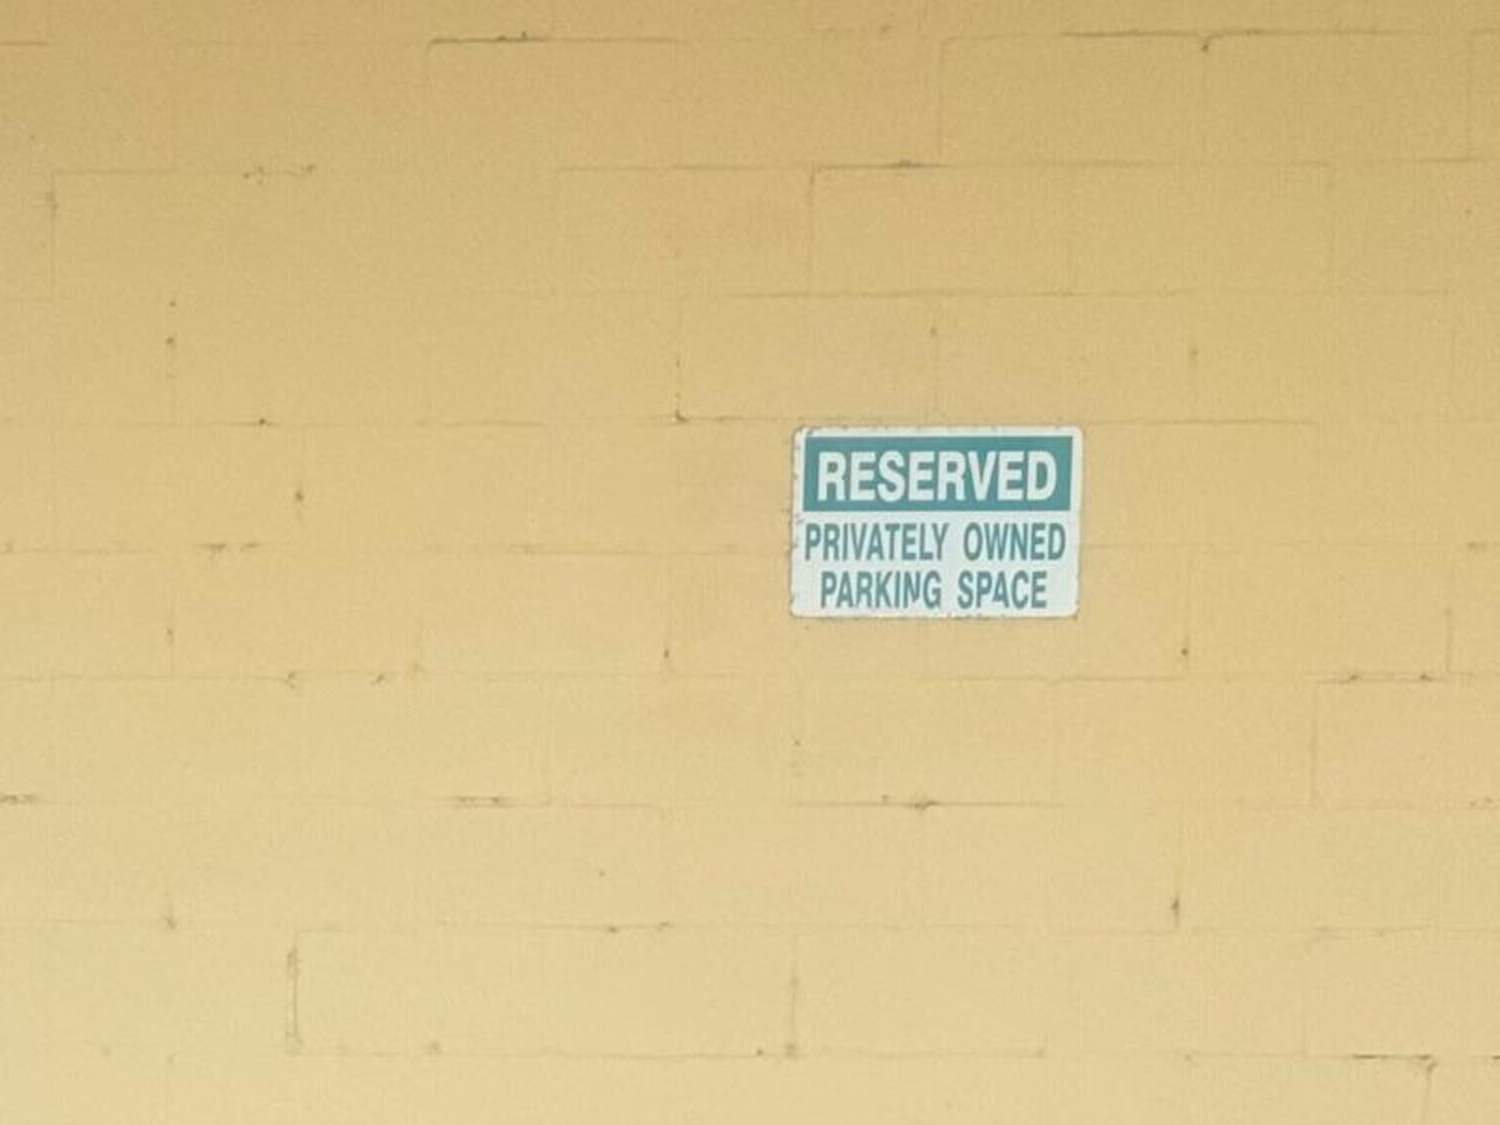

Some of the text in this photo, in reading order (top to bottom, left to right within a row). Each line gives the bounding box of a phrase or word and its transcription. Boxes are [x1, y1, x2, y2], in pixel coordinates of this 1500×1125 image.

[817, 450, 1058, 503] RESERVED
[804, 522, 1067, 561] PRIVATELY OWNED
[820, 570, 1048, 609] PARKING SPACE
